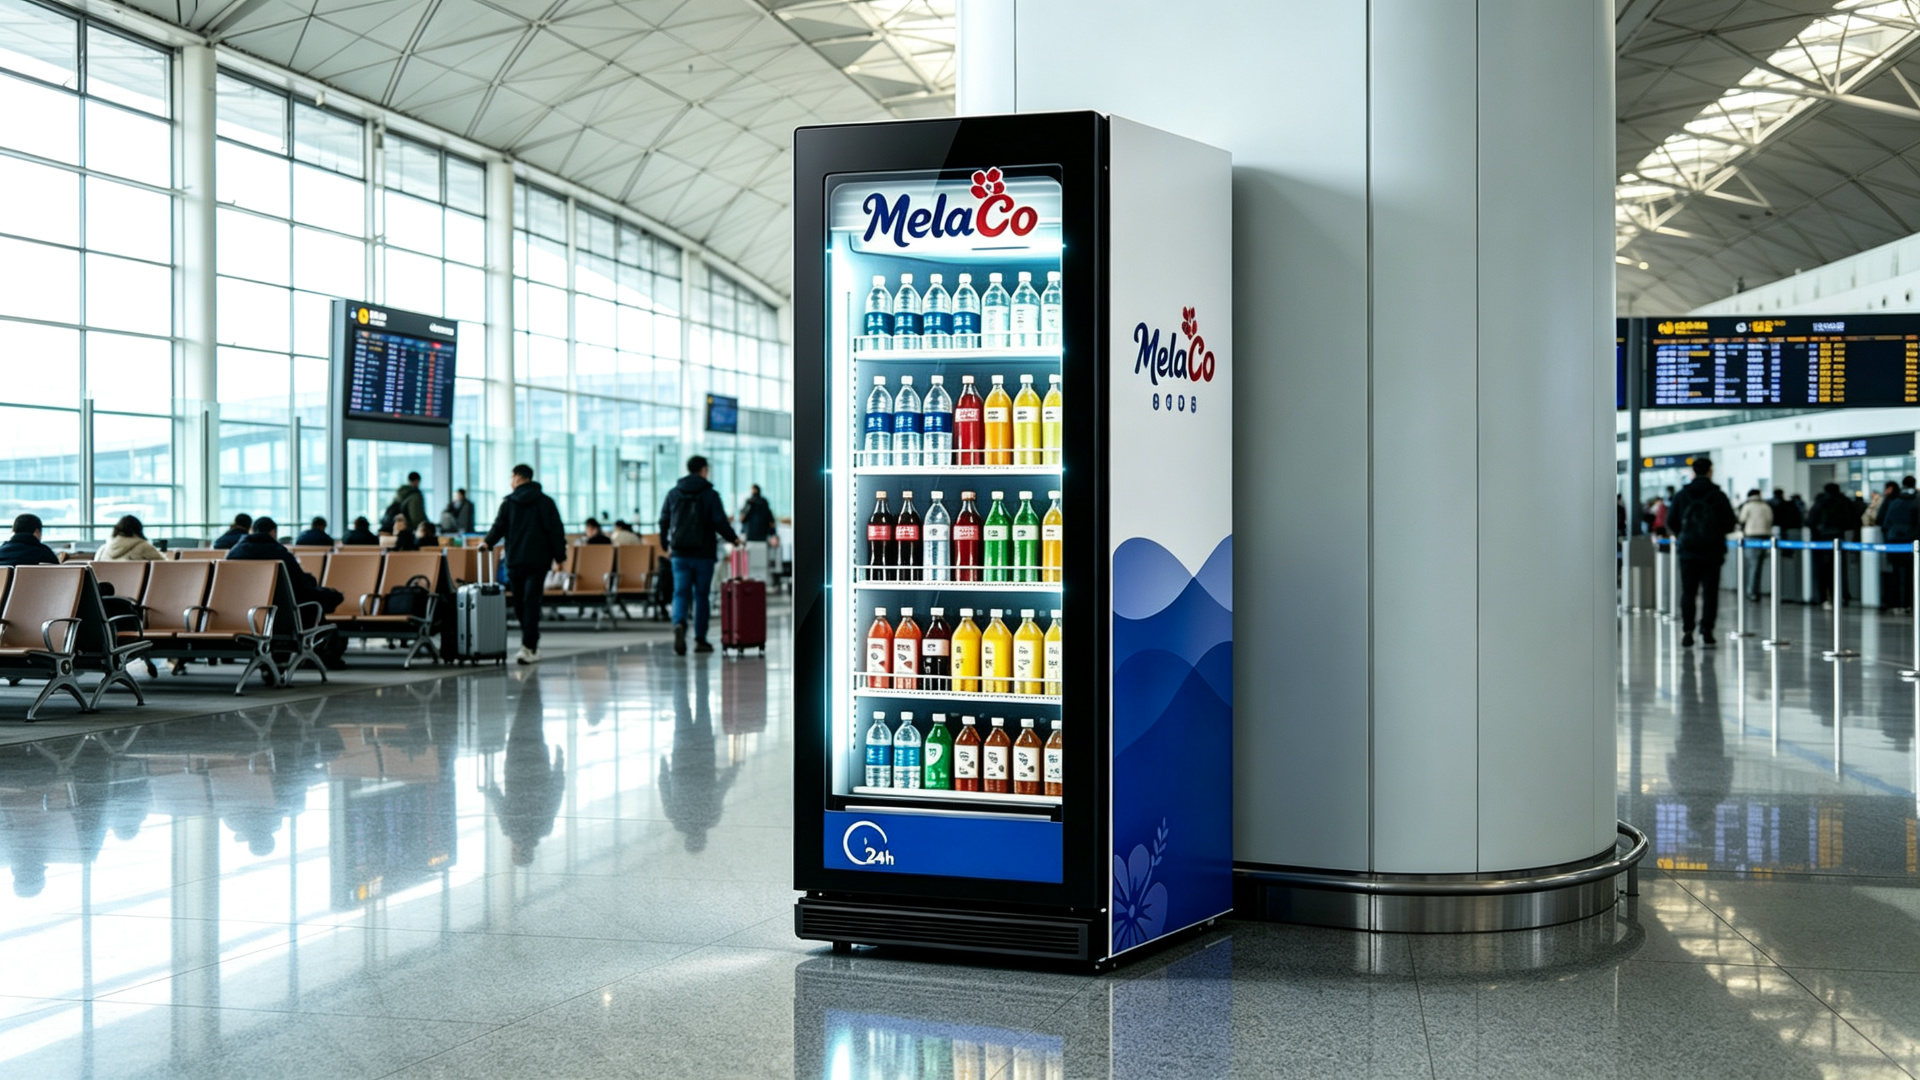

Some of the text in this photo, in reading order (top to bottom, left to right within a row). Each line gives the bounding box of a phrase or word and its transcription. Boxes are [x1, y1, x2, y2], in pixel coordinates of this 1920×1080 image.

[863, 193, 1038, 247] MelaCo
[1134, 322, 1215, 385] MelaCo
[865, 847, 895, 865] 24h
